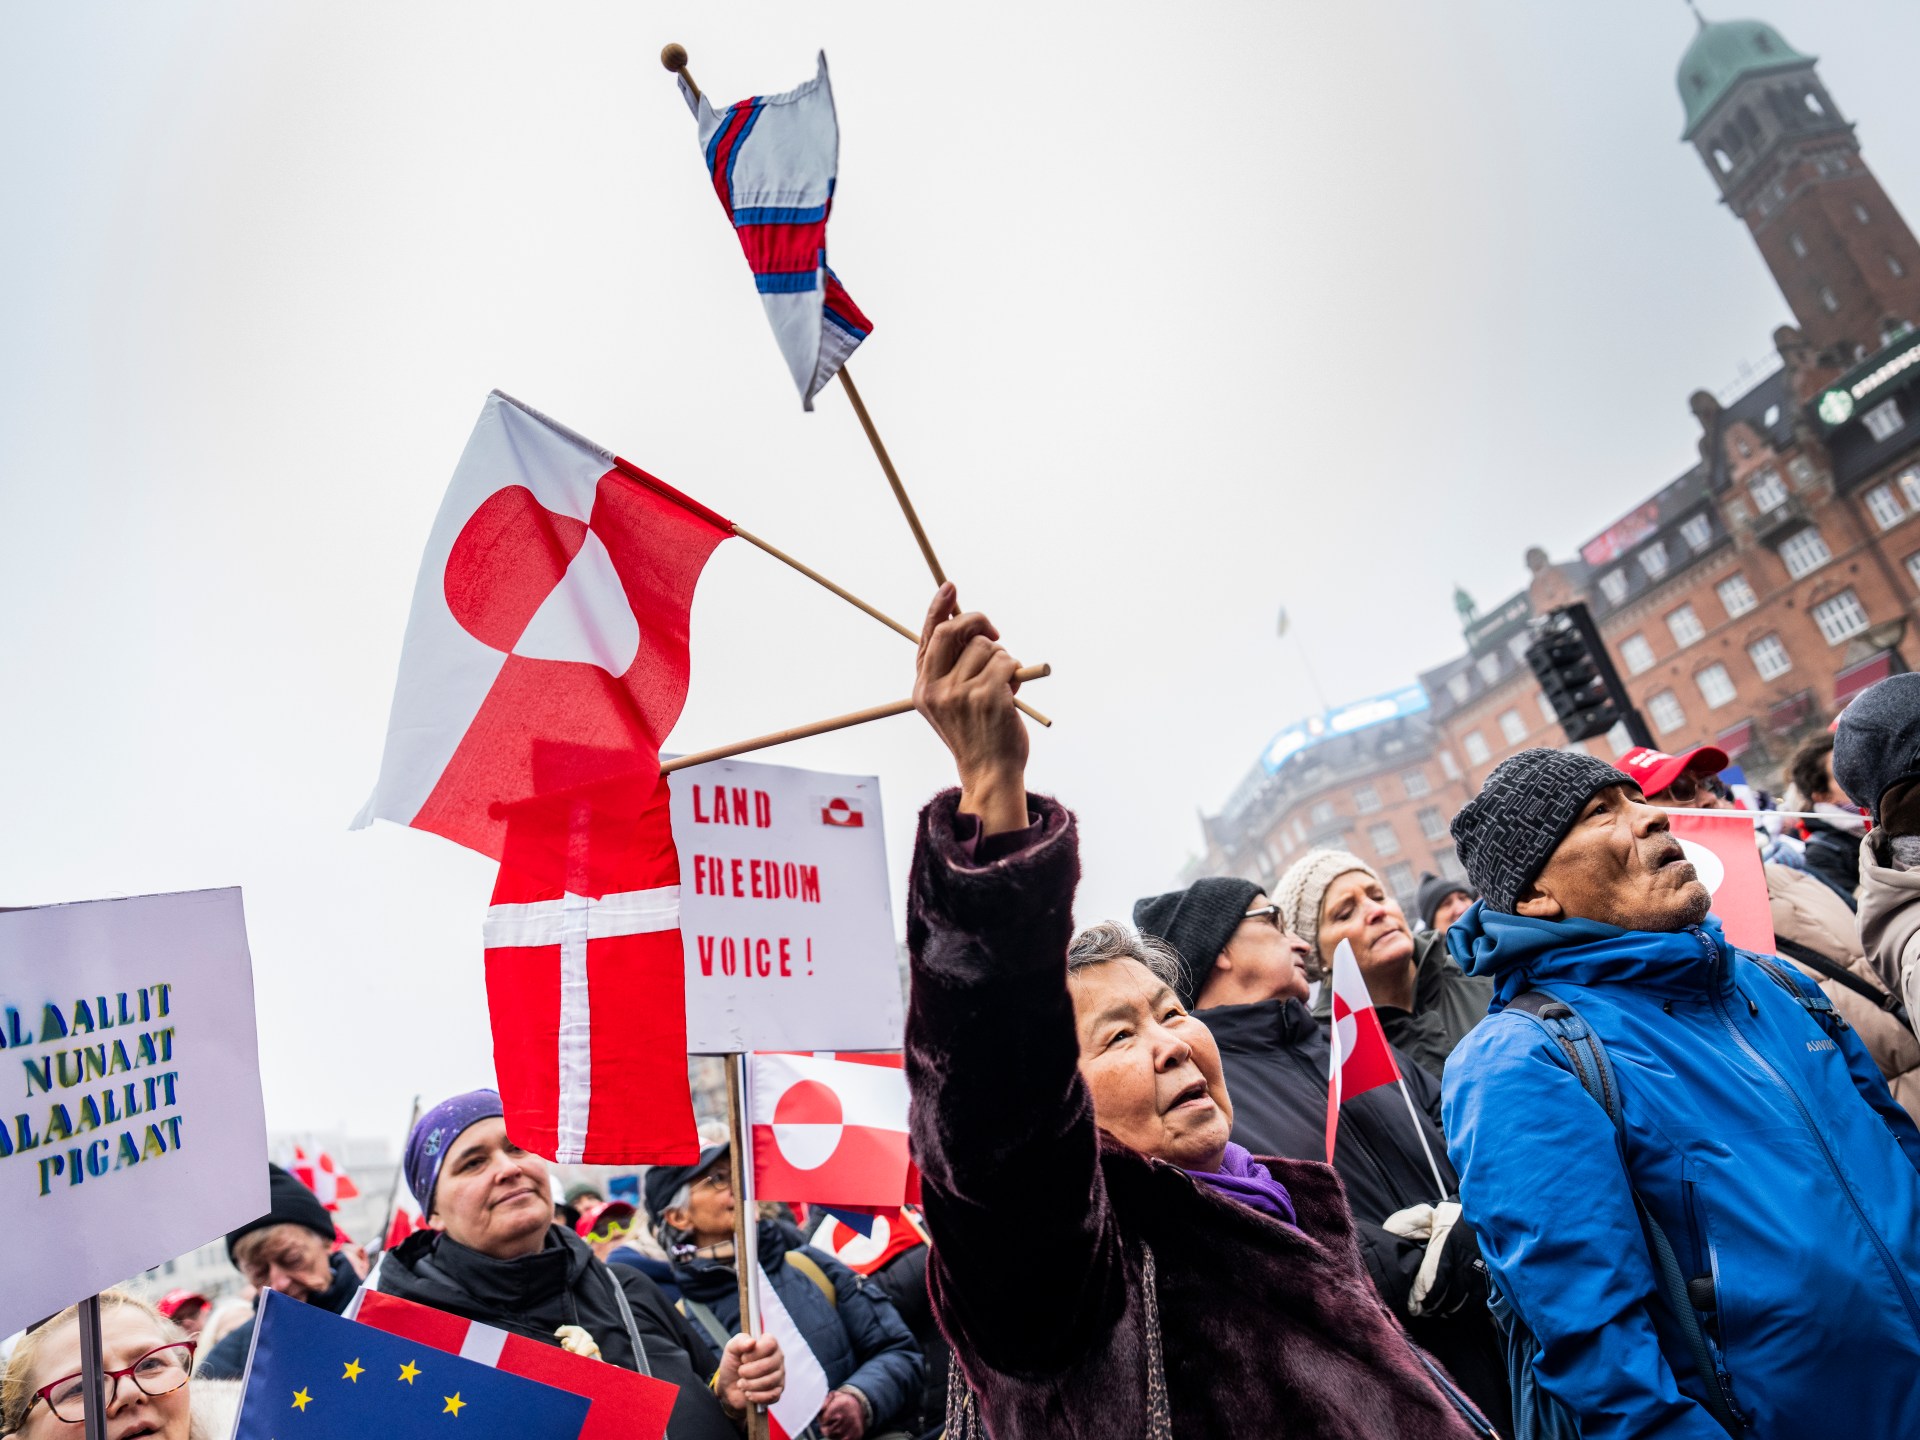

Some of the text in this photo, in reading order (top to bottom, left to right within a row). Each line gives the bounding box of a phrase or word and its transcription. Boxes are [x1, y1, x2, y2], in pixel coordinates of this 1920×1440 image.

[692, 784, 771, 828] LAND
[694, 855, 821, 903] FREEDOM
[0, 983, 172, 1050] LAALLIT
[22, 1026, 176, 1097] NUNAAT
[38, 1115, 183, 1197] PIGAAT
